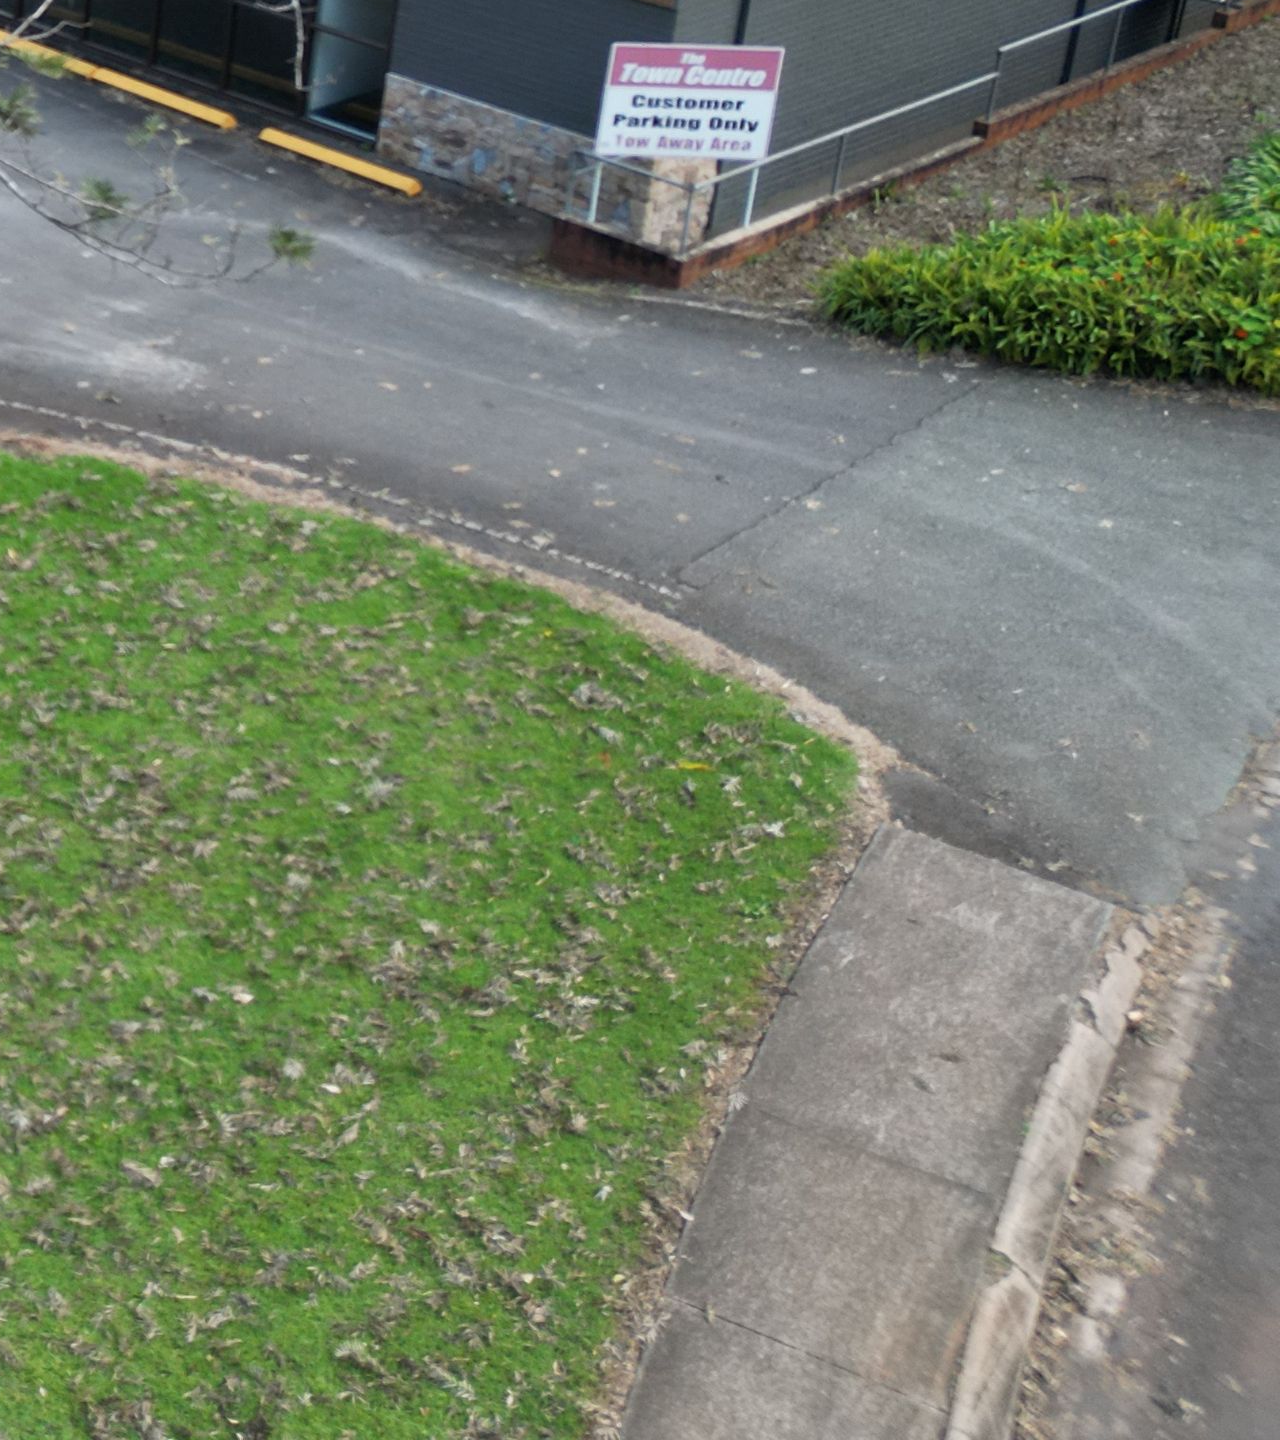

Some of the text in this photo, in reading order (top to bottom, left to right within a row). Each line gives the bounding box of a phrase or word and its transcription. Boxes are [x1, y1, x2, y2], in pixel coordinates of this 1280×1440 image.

[680, 52, 706, 65] The
[620, 63, 684, 85] Town
[631, 94, 745, 111] Customer
[612, 113, 759, 133] Parking Only
[616, 136, 752, 152] Tow Away Area
